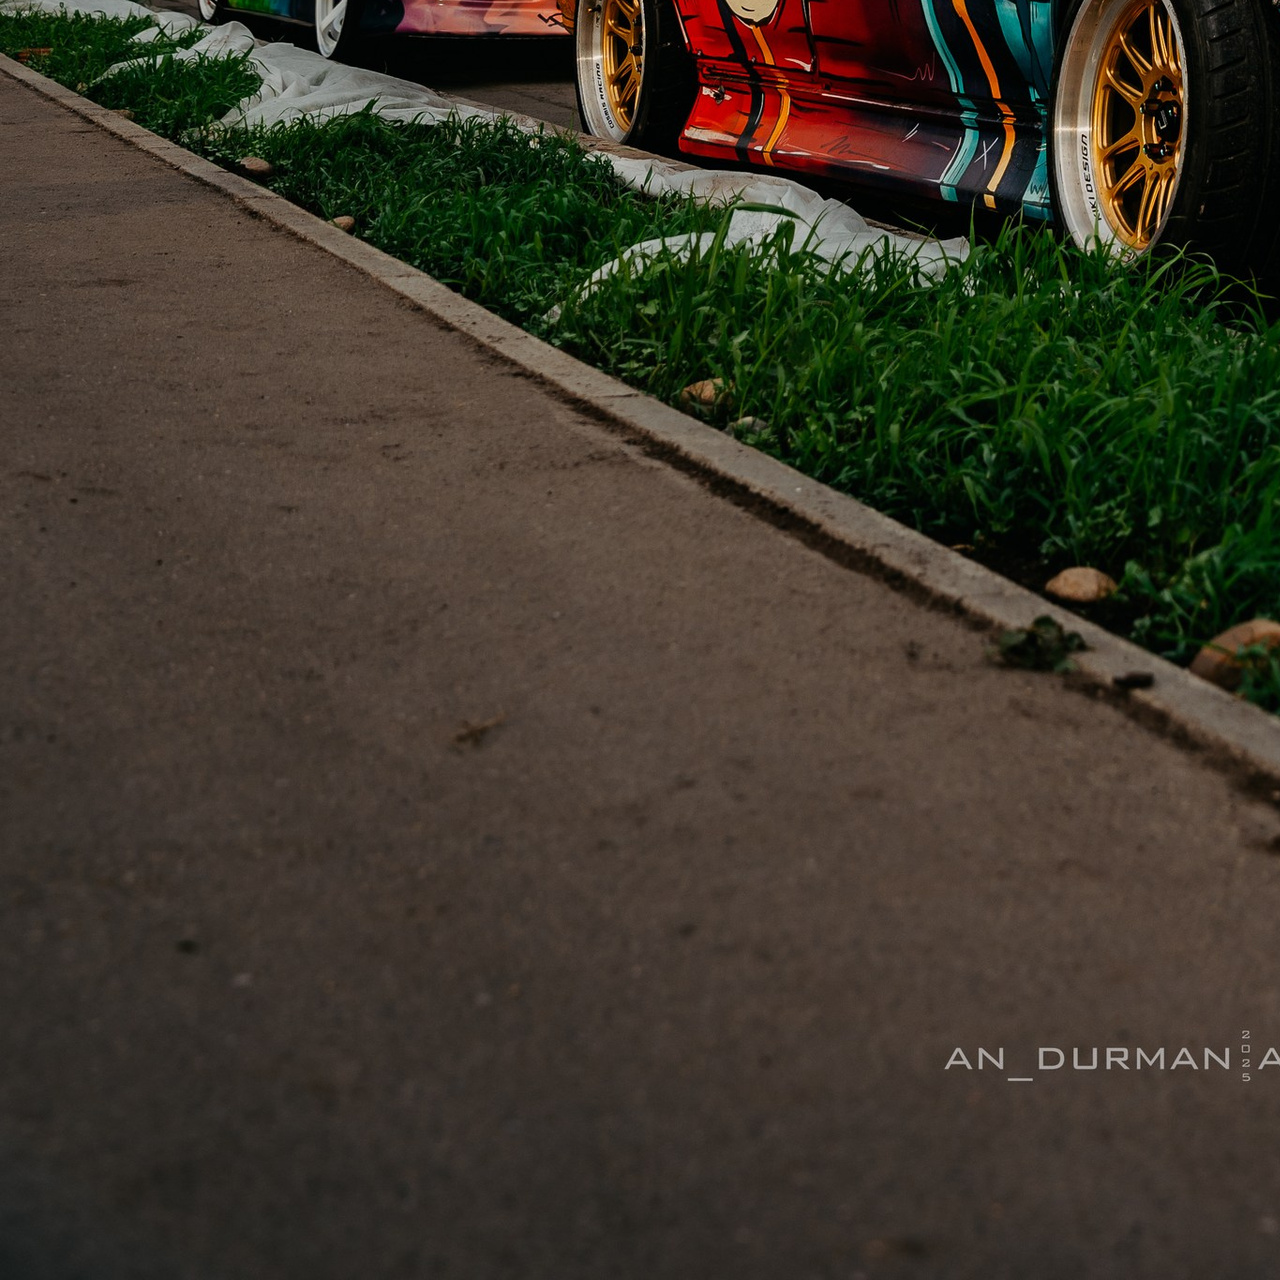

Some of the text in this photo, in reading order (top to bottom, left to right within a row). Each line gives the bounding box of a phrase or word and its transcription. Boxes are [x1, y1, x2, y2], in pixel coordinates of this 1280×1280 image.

[595, 62, 615, 129] COSMIS RACING
[1081, 133, 1093, 193] DESIGN
